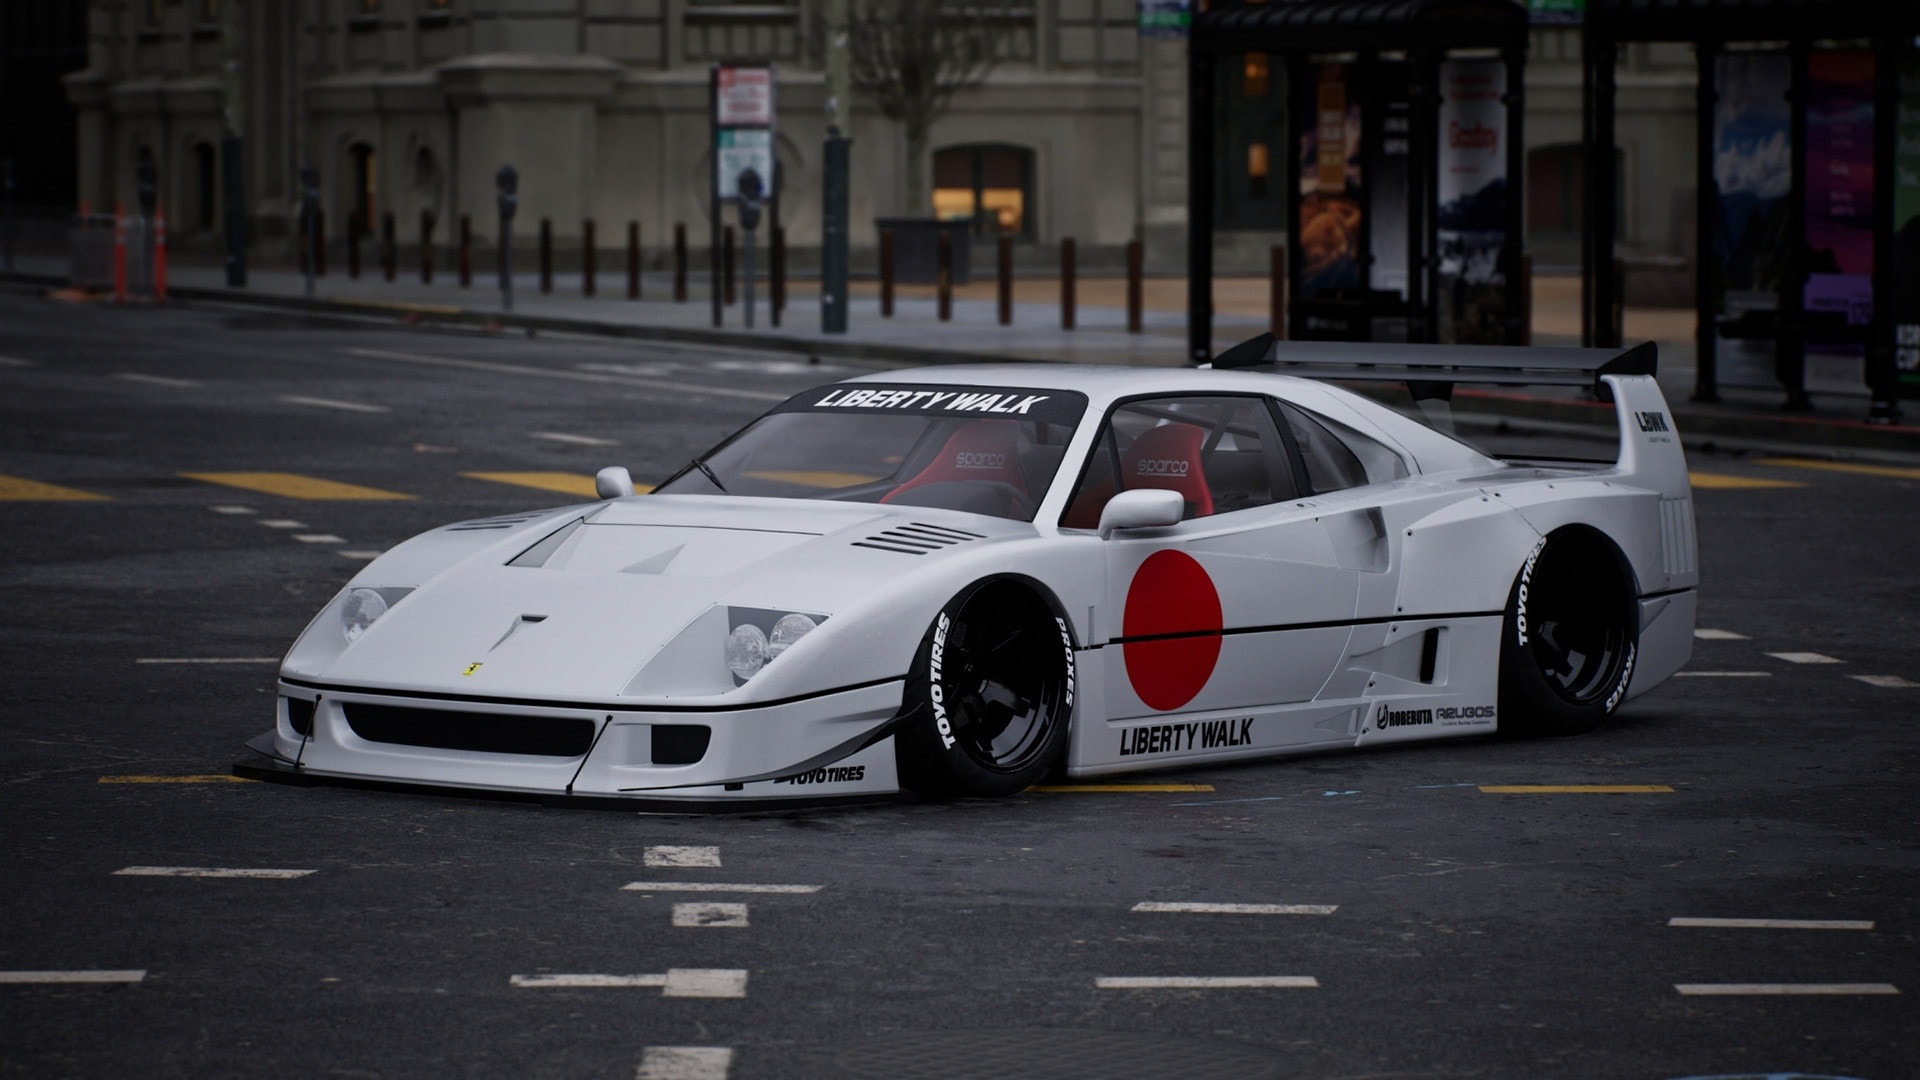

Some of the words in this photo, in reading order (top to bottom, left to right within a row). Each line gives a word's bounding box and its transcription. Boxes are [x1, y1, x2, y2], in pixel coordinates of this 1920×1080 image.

[813, 389, 958, 409] LIBERTY
[943, 391, 1050, 414] WALK
[1634, 411, 1669, 432] LBWK
[956, 452, 1005, 470] sparco
[1136, 459, 1189, 477] sparco
[1055, 616, 1076, 708] PROXES
[1605, 640, 1636, 714] PROXES
[1389, 709, 1433, 727] ROBERUTA
[1120, 723, 1199, 755] LIBERTY
[1202, 718, 1254, 748] WALK
